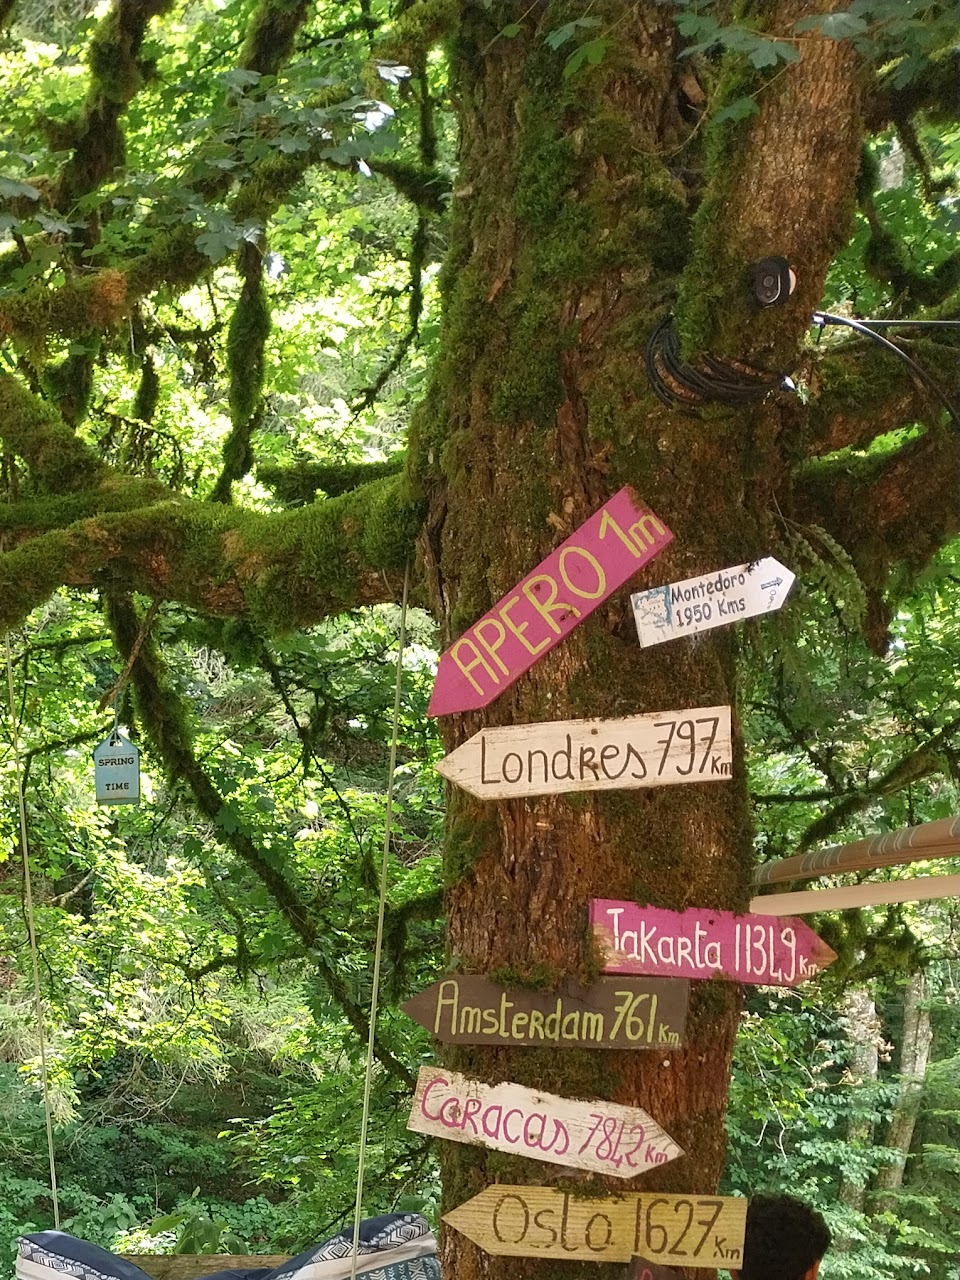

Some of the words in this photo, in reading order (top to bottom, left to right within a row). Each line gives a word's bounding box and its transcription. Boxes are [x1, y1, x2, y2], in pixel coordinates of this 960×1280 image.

[670, 572, 746, 605] Montedoro
[450, 545, 607, 696] APERO
[675, 602, 712, 627] 1950
[717, 597, 746, 617] Kms
[98, 757, 135, 767] SPRING
[105, 782, 129, 791] TIME
[493, 1193, 615, 1252] Oslo
[634, 1197, 724, 1257] 1627
